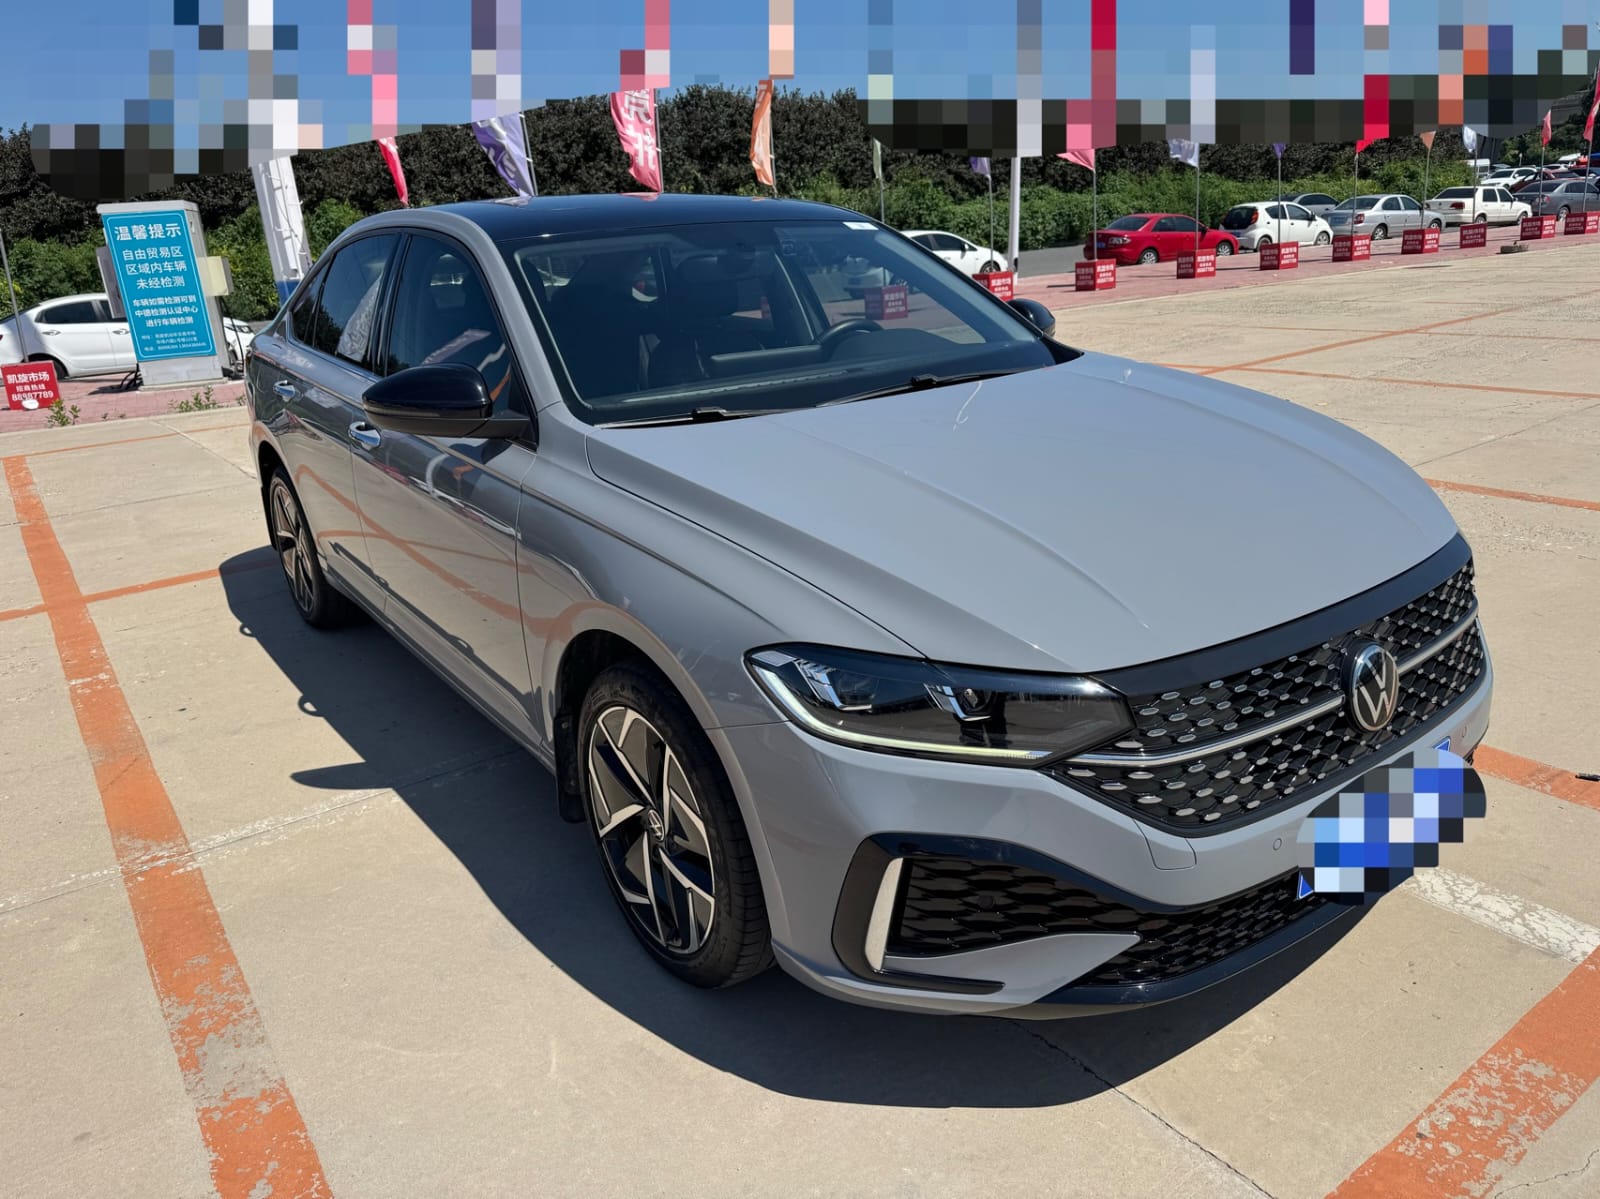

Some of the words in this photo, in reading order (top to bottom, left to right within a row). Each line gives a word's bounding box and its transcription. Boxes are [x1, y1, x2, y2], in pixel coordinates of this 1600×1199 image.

[113, 223, 182, 241] 温馨提示
[122, 245, 184, 261] 自由贸易区
[125, 261, 187, 276] 区域内车辆
[136, 275, 186, 290] 未经检测
